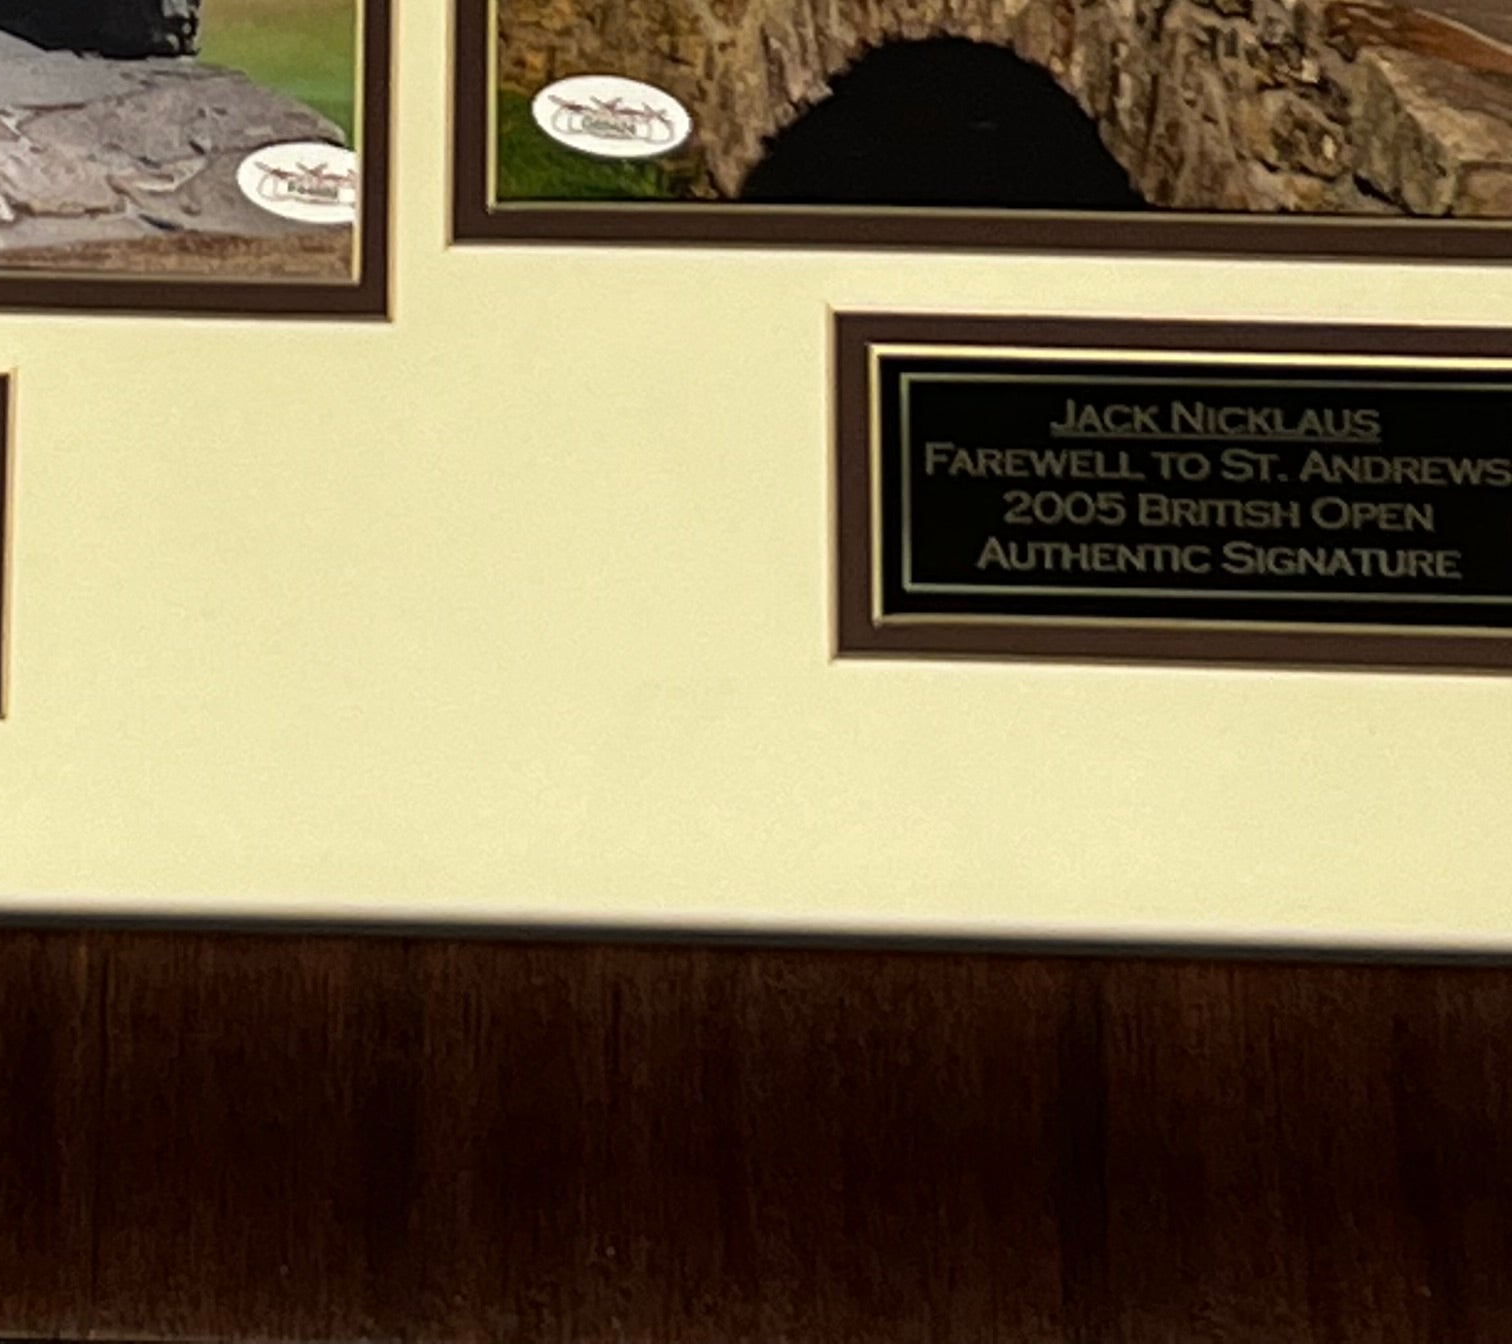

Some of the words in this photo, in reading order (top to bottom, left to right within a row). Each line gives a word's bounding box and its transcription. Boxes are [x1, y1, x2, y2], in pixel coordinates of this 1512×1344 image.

[1050, 398, 1160, 435] JACK
[1170, 400, 1381, 439] NICKLAUS
[924, 442, 1145, 479] FAREWELL
[1153, 451, 1210, 479] TO
[1220, 449, 1288, 483] ST.
[1299, 451, 1512, 486] ANDREWS
[1003, 491, 1125, 525] 2005
[1138, 493, 1300, 528] BRITISH
[1311, 496, 1434, 531] OPEN
[977, 537, 1210, 574] AUTHENTIC
[1221, 541, 1462, 580] SIGNATURE
